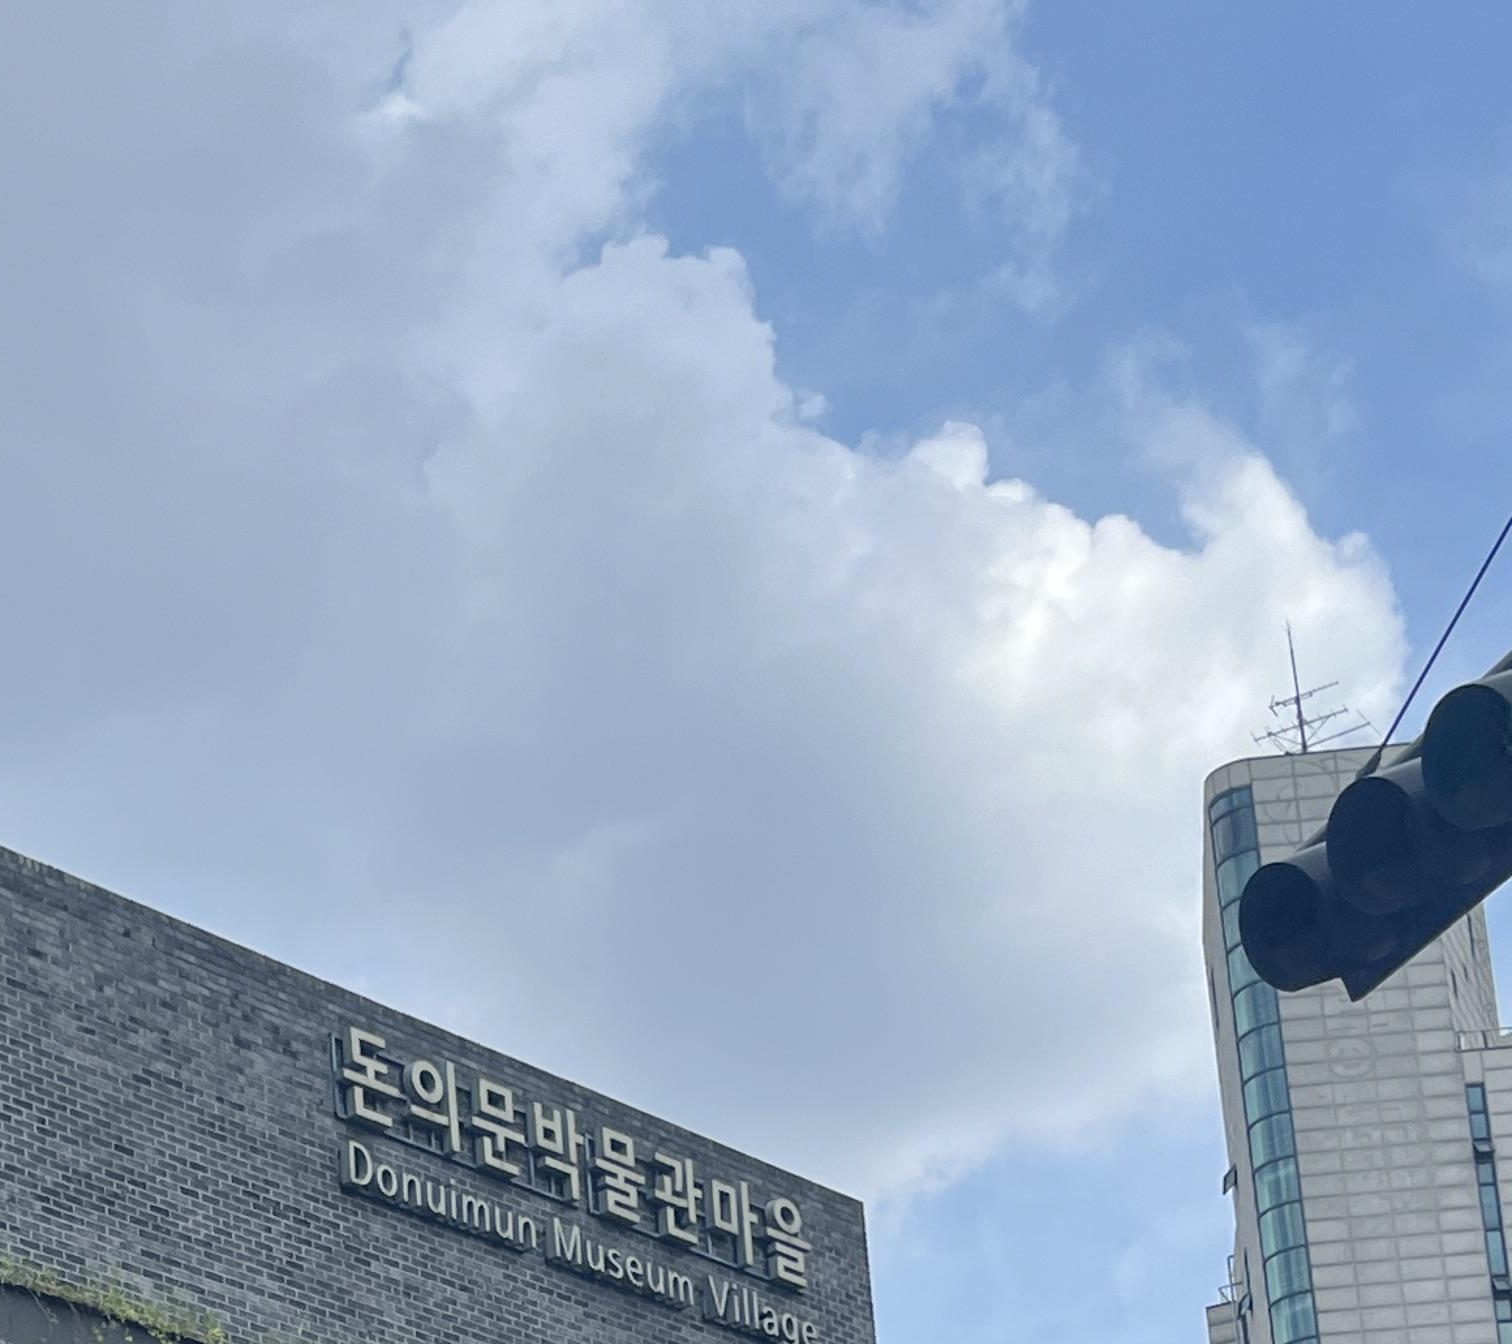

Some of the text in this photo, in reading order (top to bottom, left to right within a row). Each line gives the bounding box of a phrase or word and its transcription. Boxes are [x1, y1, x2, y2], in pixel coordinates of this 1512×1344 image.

[340, 1026, 812, 1290] 돈의문박물관마을
[346, 1140, 539, 1250] Donuimun
[550, 1216, 695, 1306] Museum
